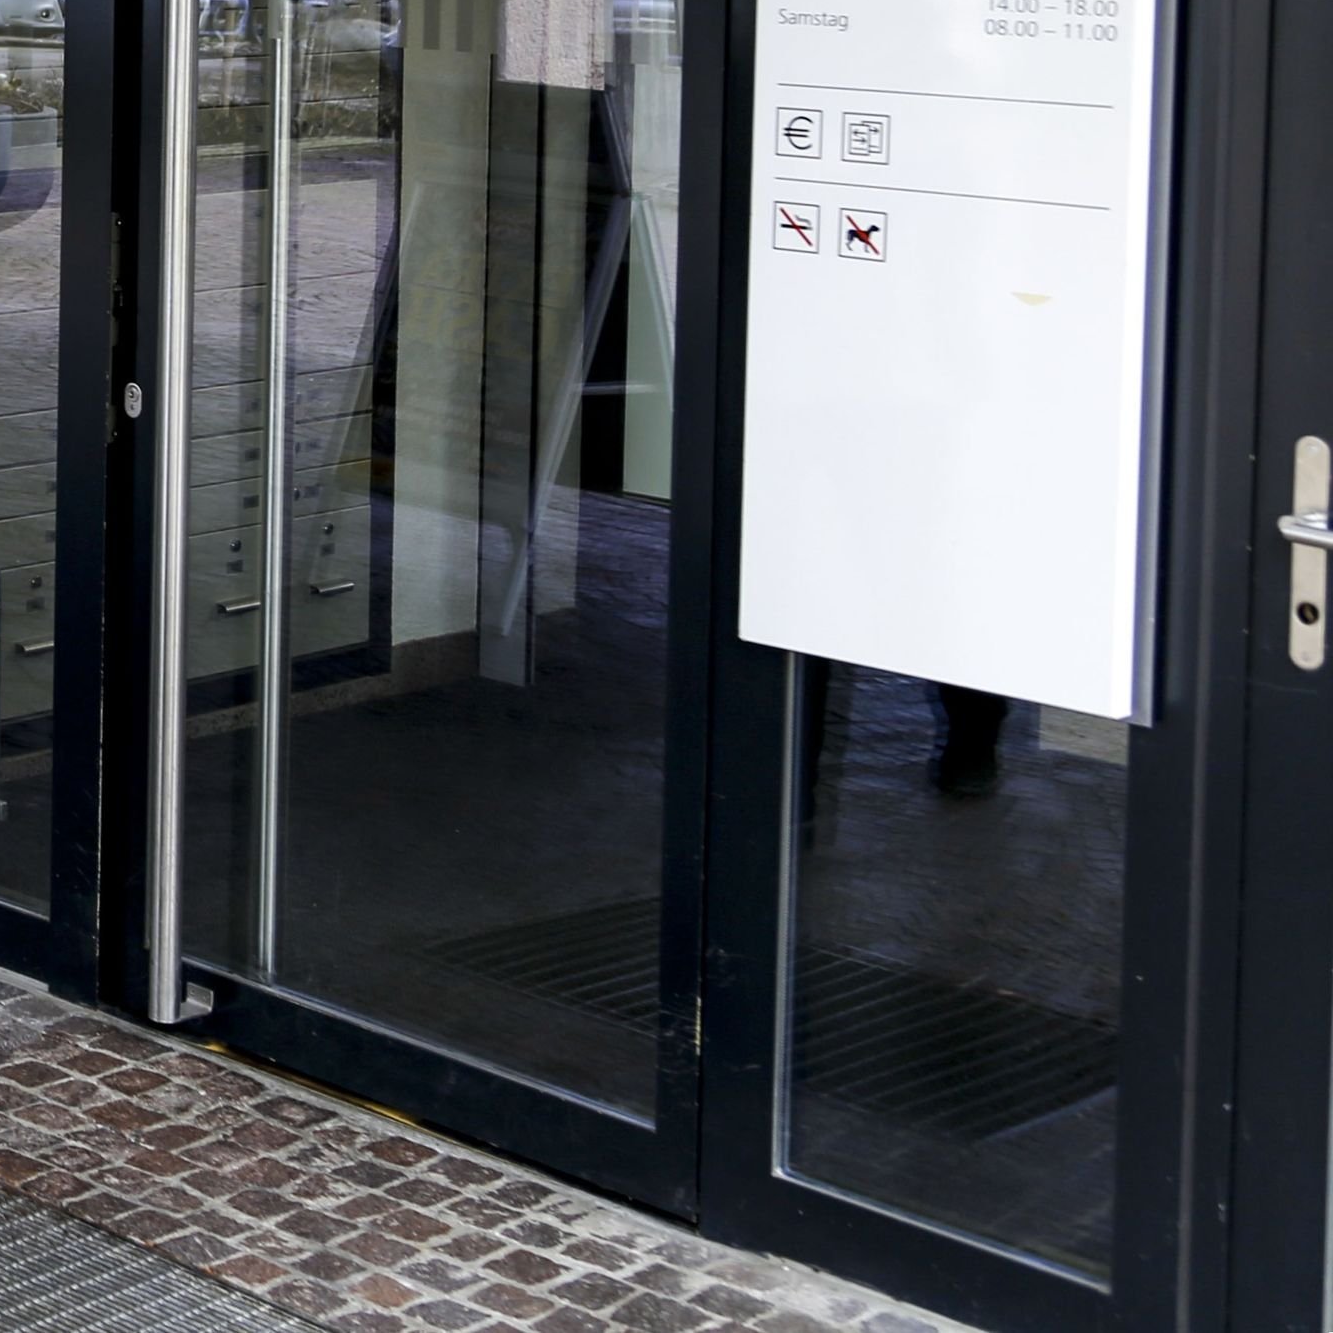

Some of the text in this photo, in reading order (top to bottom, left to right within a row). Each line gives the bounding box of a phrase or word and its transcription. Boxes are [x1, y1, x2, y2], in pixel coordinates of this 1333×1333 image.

[777, 8, 850, 32] Samstag
[984, 18, 1039, 38] 08.00
[1063, 23, 1118, 42] 11.00
